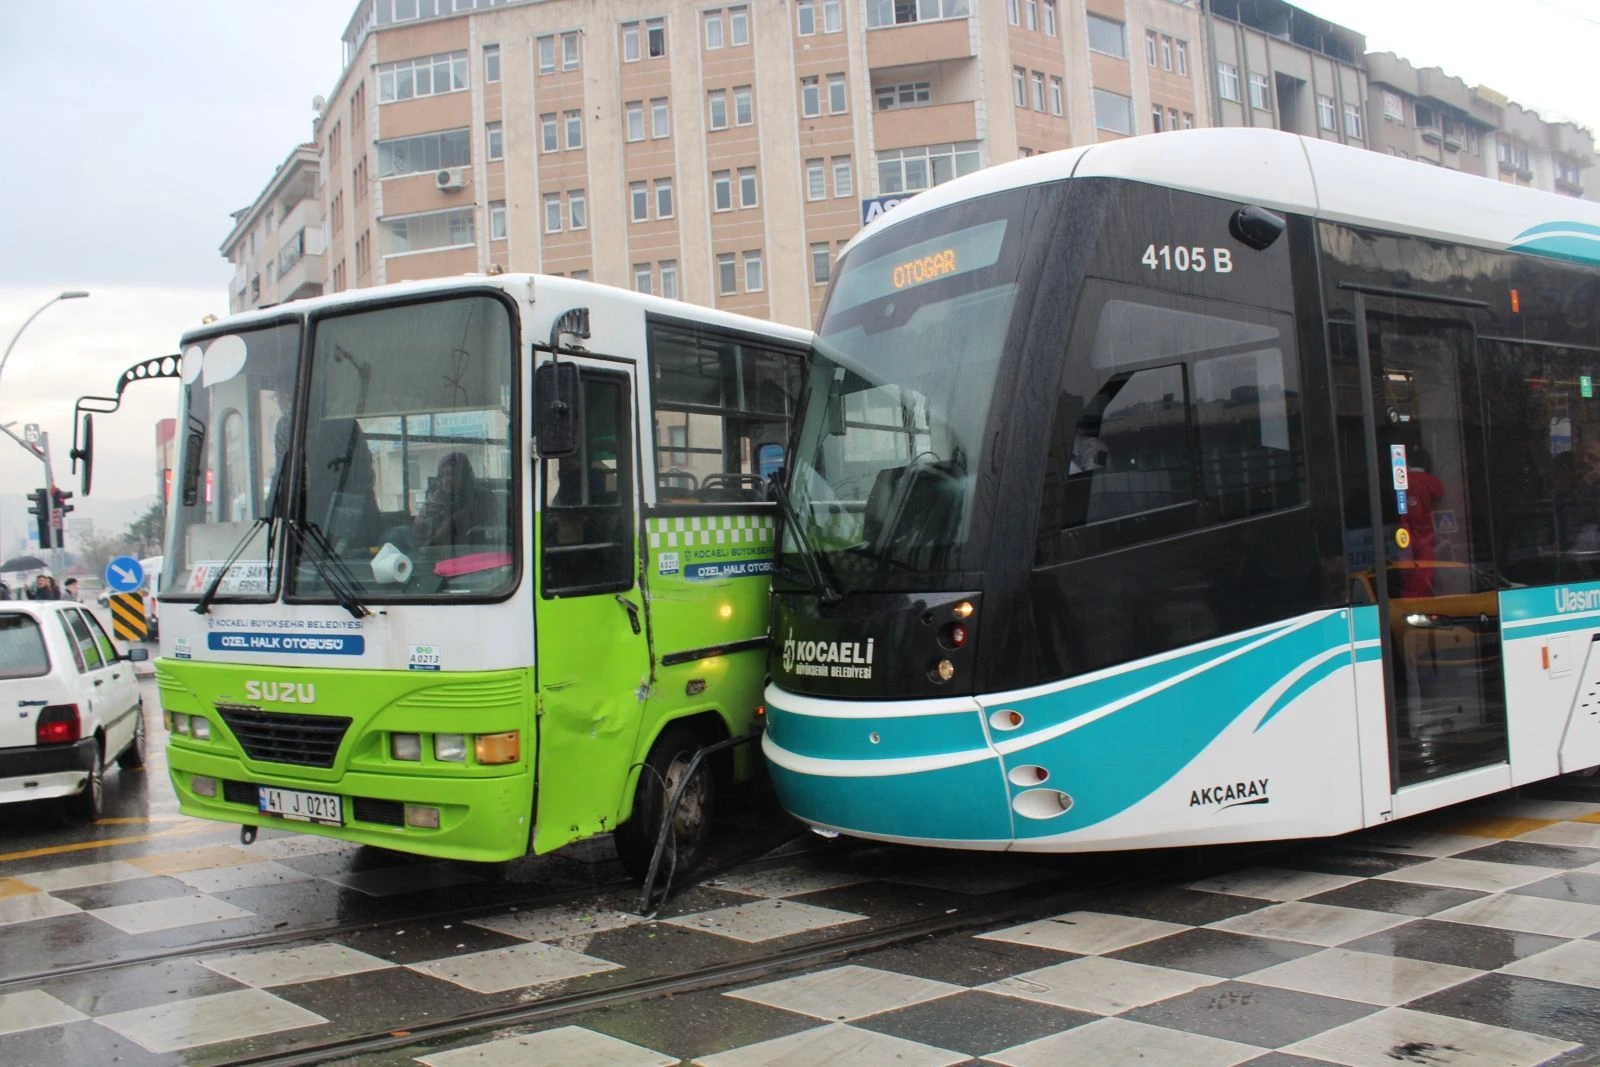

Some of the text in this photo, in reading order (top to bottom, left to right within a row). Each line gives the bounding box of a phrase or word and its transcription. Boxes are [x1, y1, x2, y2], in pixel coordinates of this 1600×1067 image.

[893, 249, 956, 288] OTOGAR
[1142, 244, 1233, 273] 4105 B
[723, 564, 746, 575] HALK
[1555, 588, 1600, 613] Ulaşım
[251, 636, 281, 649] HALK
[797, 638, 874, 664] KOCAELİ
[245, 680, 316, 704] SUZU
[269, 791, 282, 810] 41
[293, 794, 300, 812] J
[306, 796, 337, 817] 0213
[1190, 779, 1269, 807] AKÇARAY
